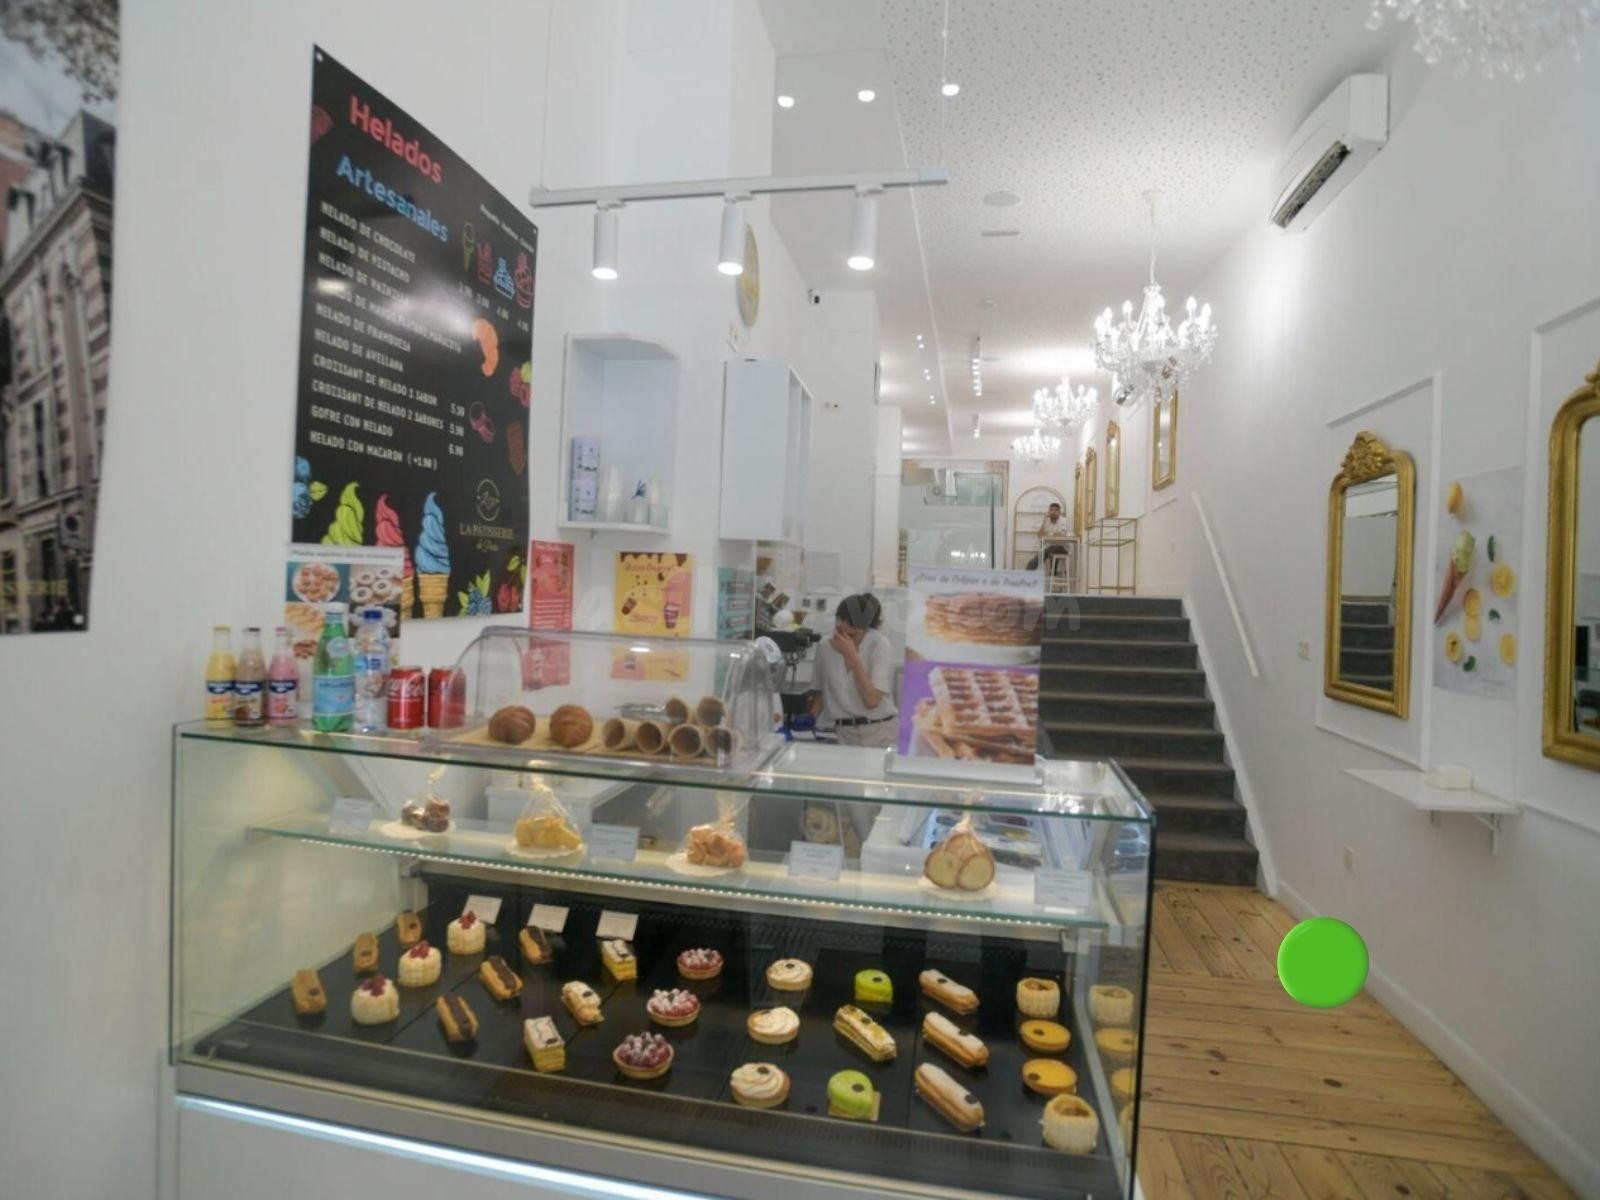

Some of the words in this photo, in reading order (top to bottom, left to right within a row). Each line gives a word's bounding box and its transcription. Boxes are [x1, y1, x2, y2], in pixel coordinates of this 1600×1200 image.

[350, 96, 442, 183] Helados
[336, 155, 448, 242] Artesanales
[319, 227, 355, 254] HELADO
[358, 244, 369, 260] DE
[372, 251, 411, 284] PISTACHO
[321, 200, 356, 230] HELADO
[360, 219, 371, 238] DE
[373, 226, 416, 264] CHOCOLATE
[318, 252, 353, 279] HELADO
[356, 269, 368, 286] DE
[316, 302, 351, 327] HELADO
[353, 318, 365, 334] DE
[367, 324, 411, 352] FRAMBUESA
[355, 294, 366, 310] DE
[314, 328, 349, 352] HELADO
[351, 343, 363, 356] DE
[365, 347, 403, 372] AVELLANA
[311, 379, 362, 408] CROISSANT
[364, 397, 377, 411] DE
[377, 400, 406, 419] HELADO
[413, 411, 444, 430] SABORES
[313, 353, 362, 383] CROISSANT
[365, 371, 377, 386] DE
[378, 376, 407, 396] HELADO
[415, 389, 438, 406] SABOR
[311, 404, 341, 424] GOFRE
[343, 414, 360, 429] CON
[362, 418, 394, 437] HELADO
[310, 430, 345, 450] HELADO
[347, 439, 364, 455] CON
[367, 445, 403, 462] MACARON
